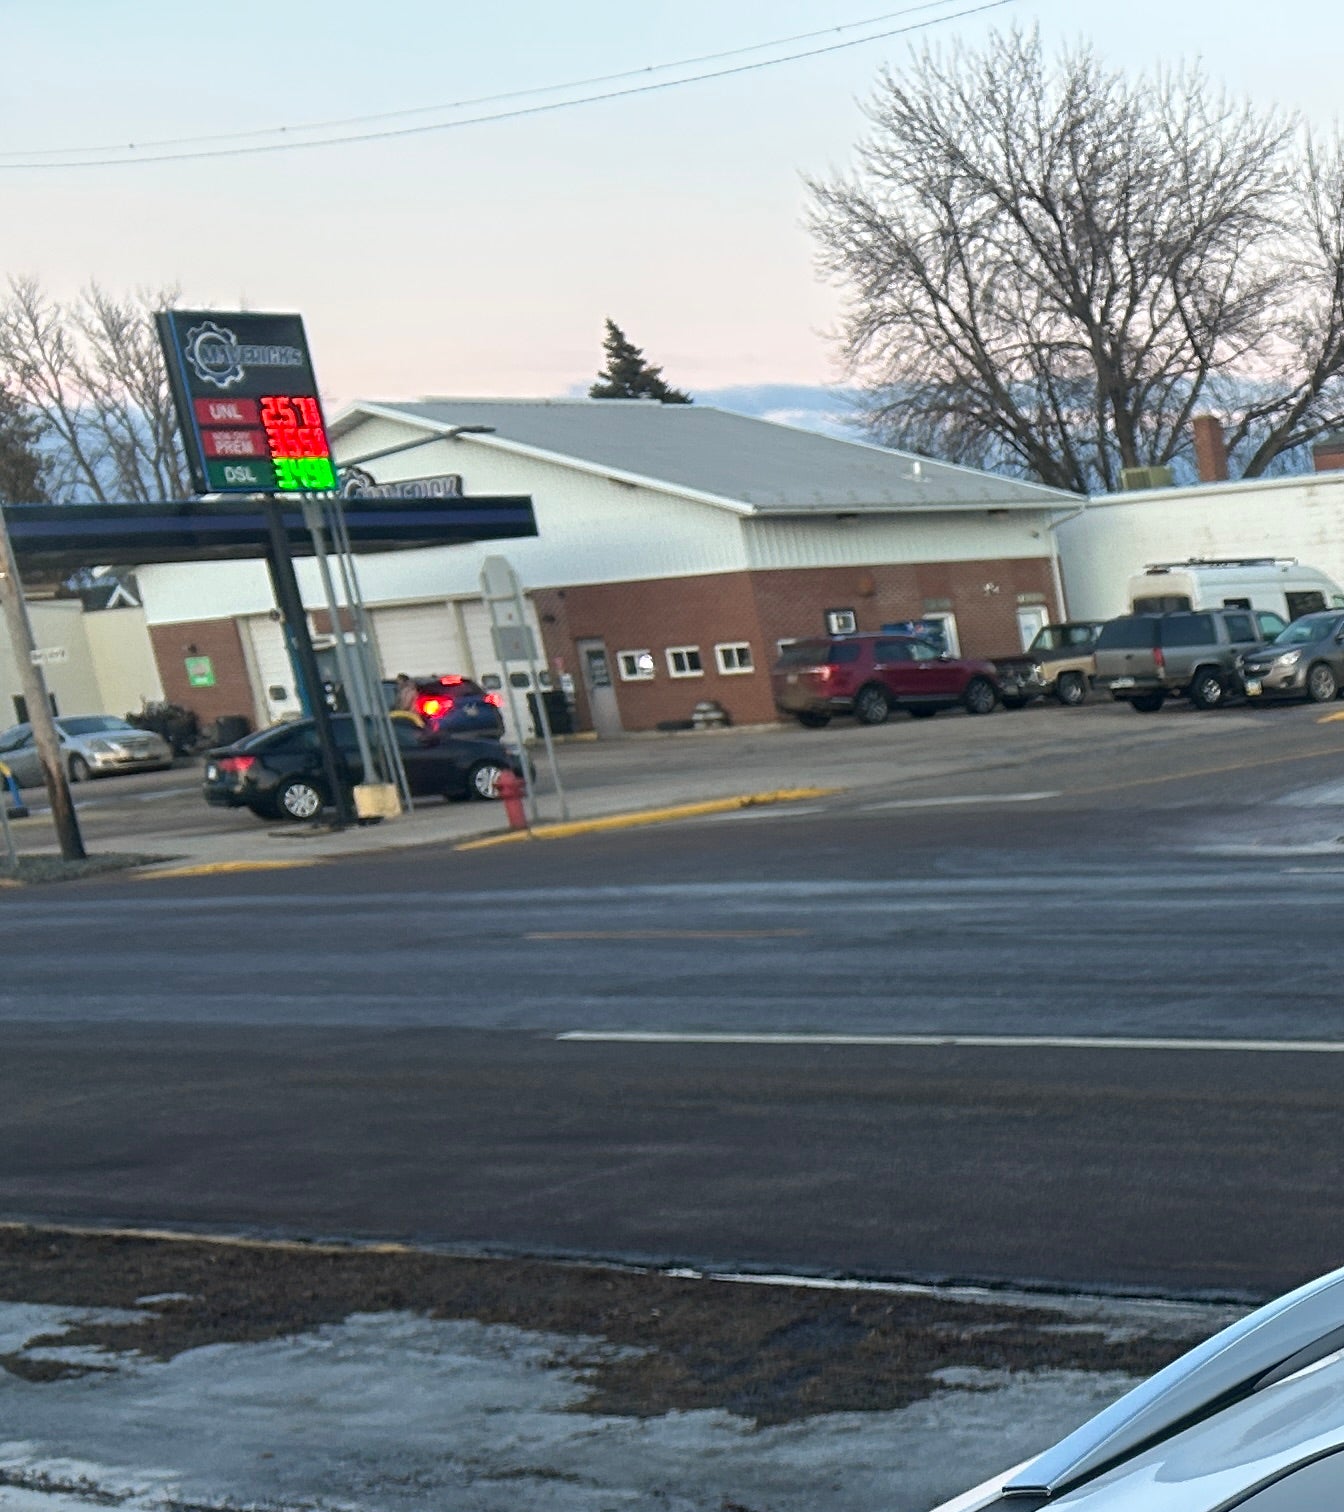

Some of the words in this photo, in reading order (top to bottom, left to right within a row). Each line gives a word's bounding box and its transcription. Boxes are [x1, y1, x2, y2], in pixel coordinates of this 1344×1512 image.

[209, 403, 243, 419] UNL
[215, 440, 254, 454] PREM
[224, 466, 256, 483] DSL
